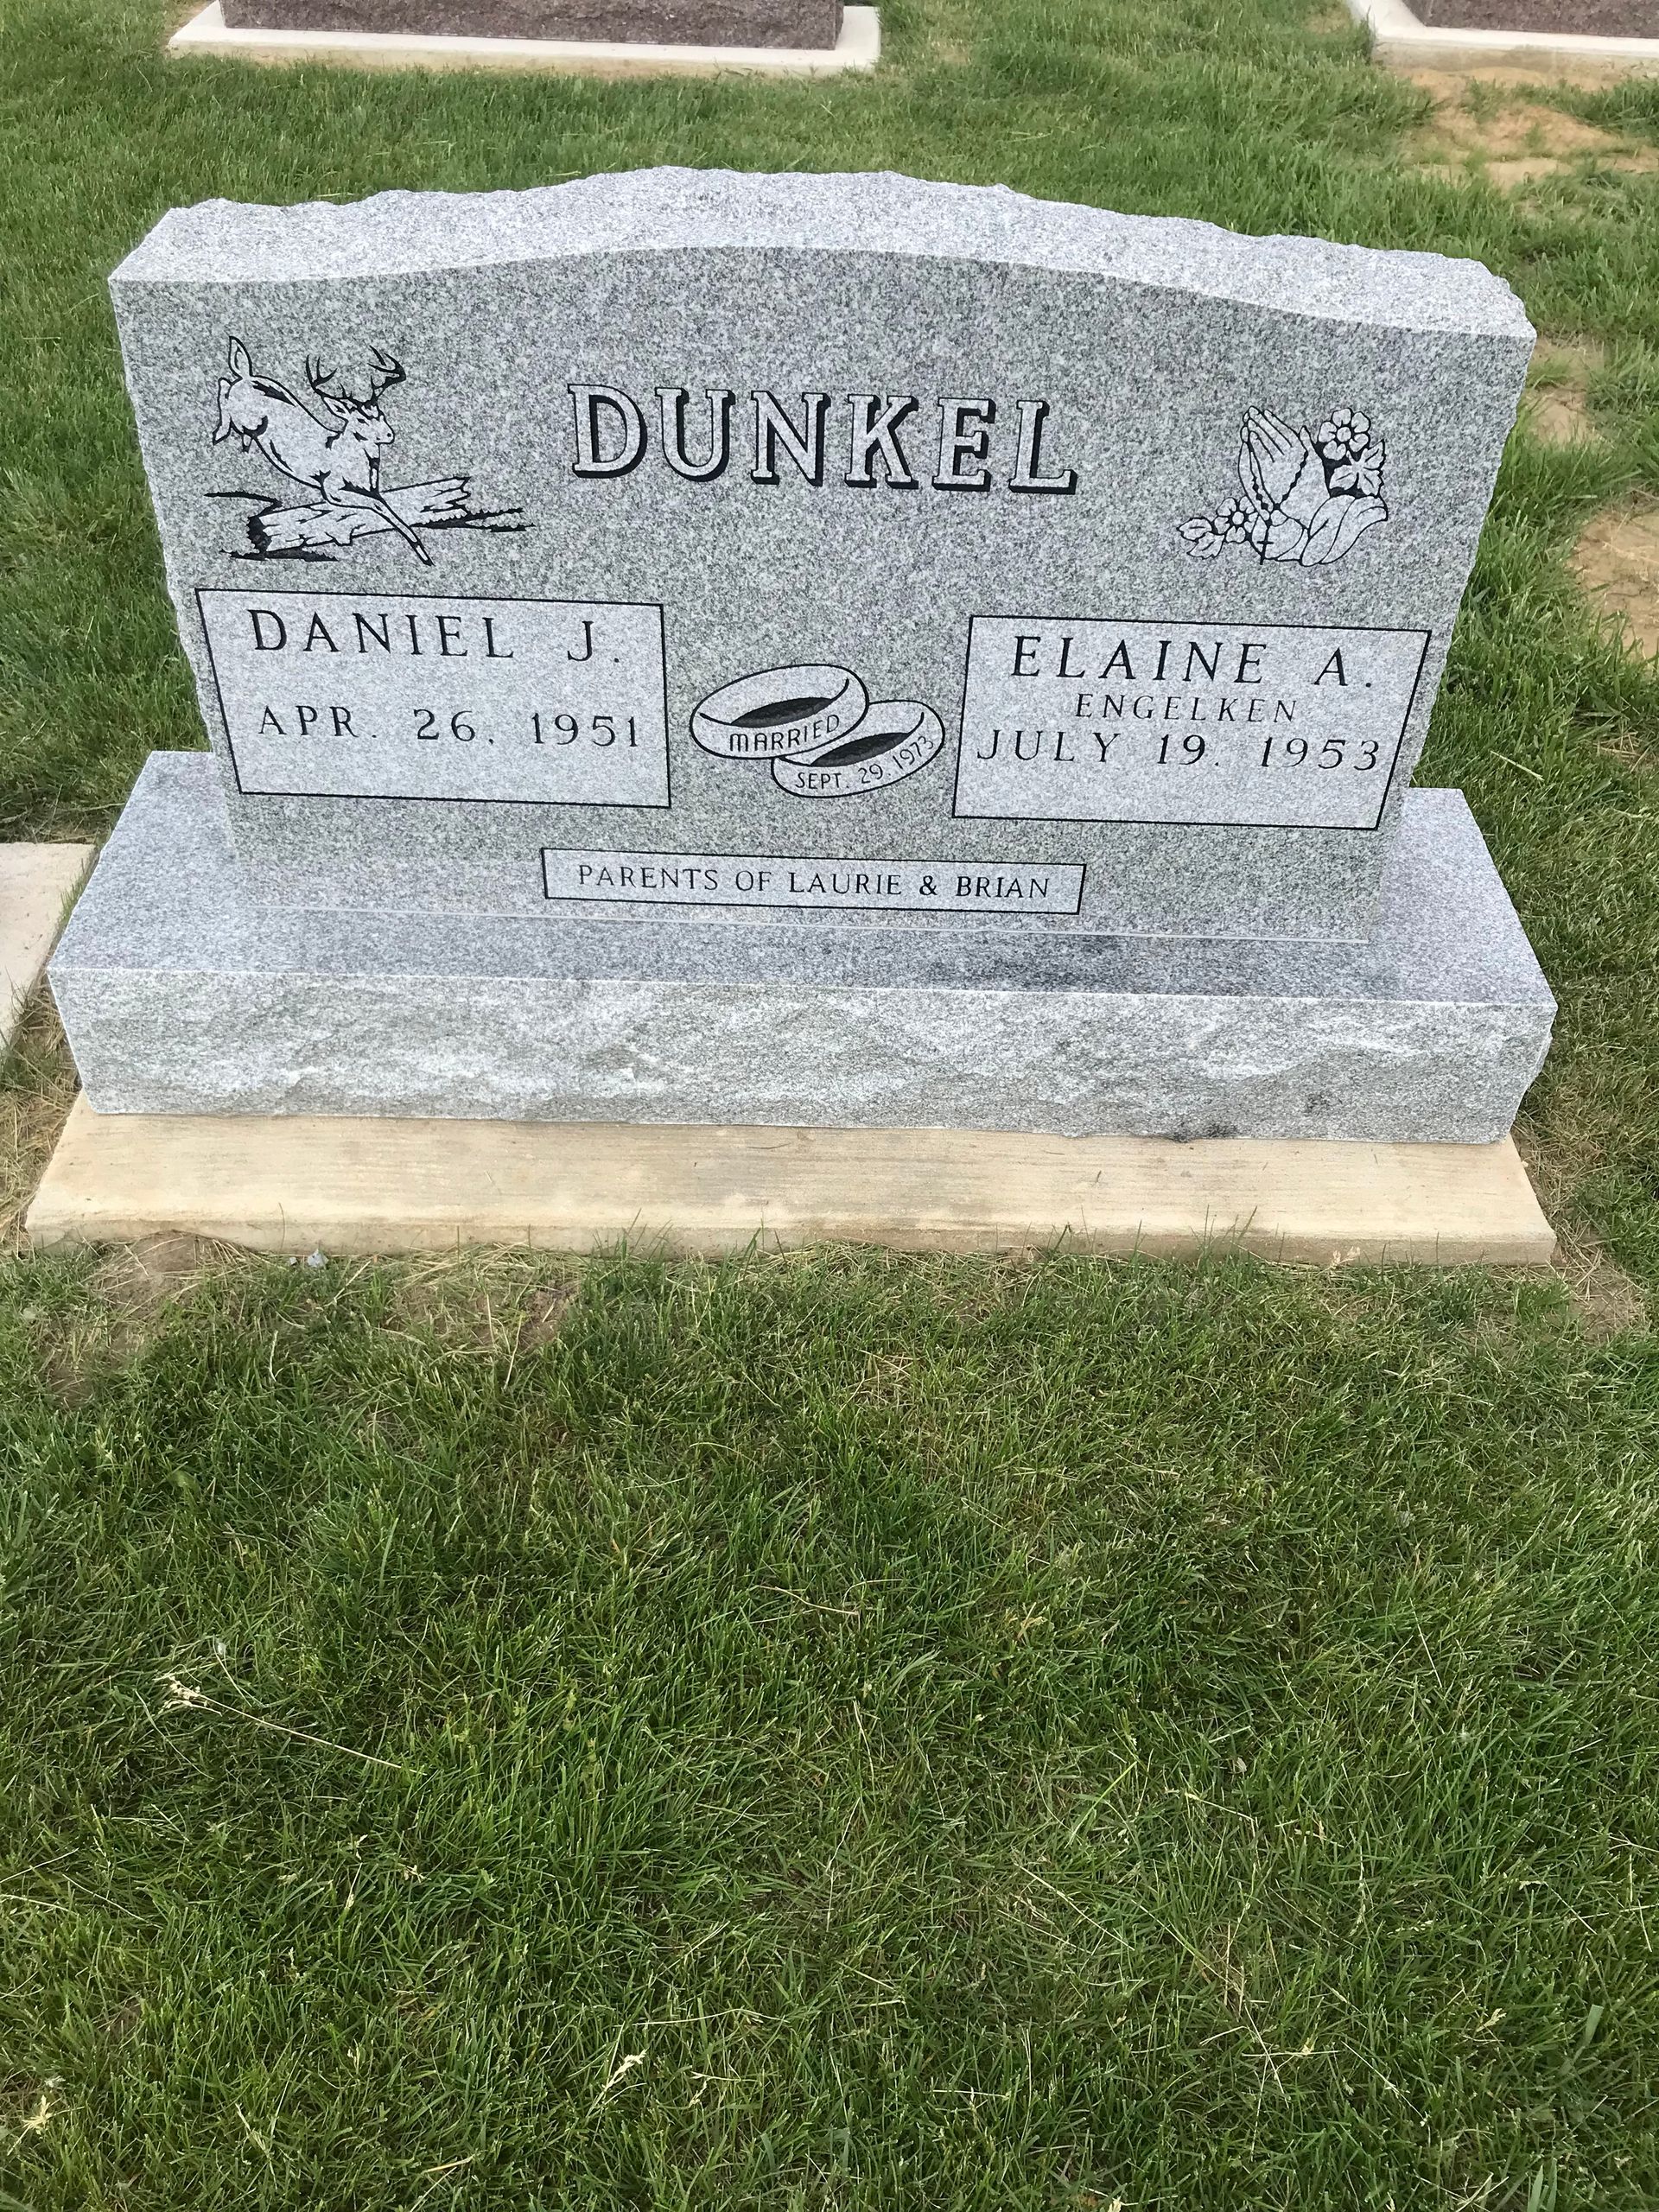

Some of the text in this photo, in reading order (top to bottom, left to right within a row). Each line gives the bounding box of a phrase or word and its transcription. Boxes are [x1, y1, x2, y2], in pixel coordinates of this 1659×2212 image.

[567, 383, 1078, 495] DUNKEL
[247, 608, 620, 664] DANIEL J.
[1011, 635, 1373, 688] ELAINE A.
[258, 704, 378, 739] APR.
[531, 712, 639, 747] 1951
[1076, 693, 1297, 722] ENGELKEN
[729, 714, 840, 752] MARRIED
[976, 729, 1122, 763] JULY
[1261, 736, 1380, 772] 1953
[795, 772, 850, 790] SEPT.
[892, 735, 934, 771] 1973
[579, 864, 1050, 899] PARENTS OF LAURIE & BRIAN
